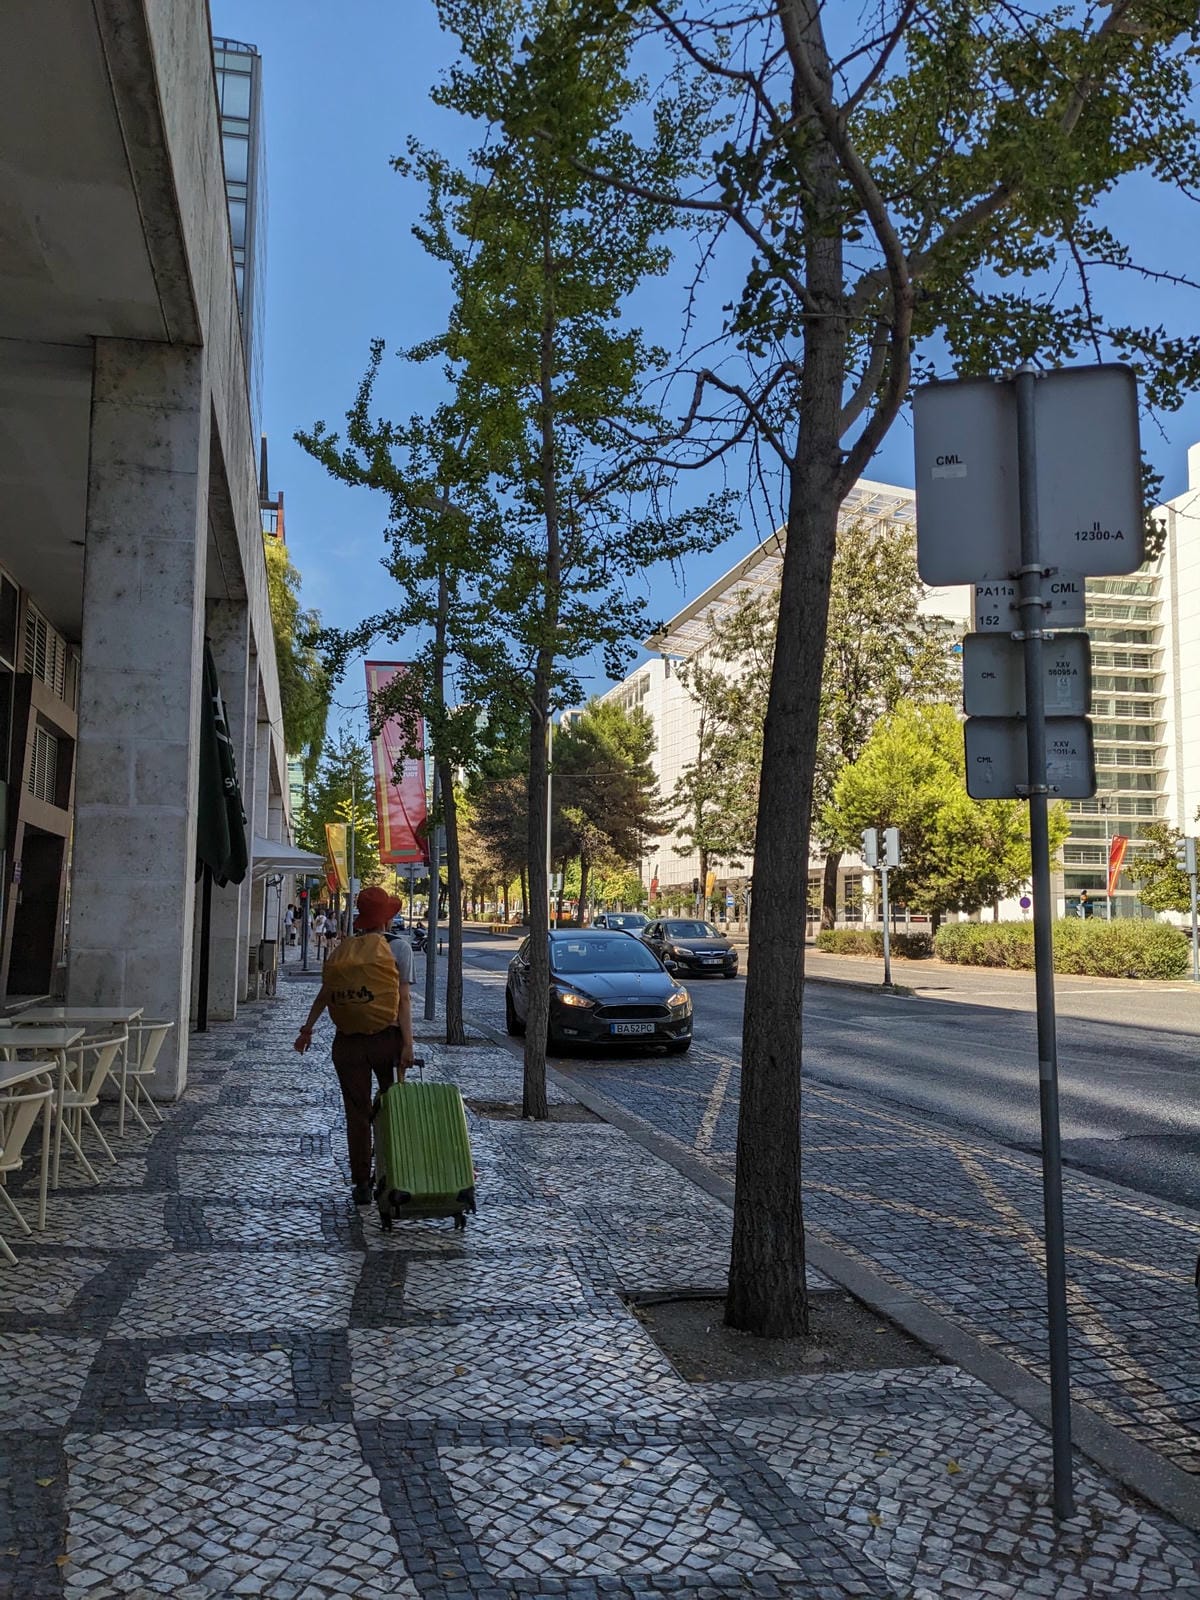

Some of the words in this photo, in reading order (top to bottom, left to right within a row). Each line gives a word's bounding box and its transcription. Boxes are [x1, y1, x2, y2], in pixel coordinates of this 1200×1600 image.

[936, 454, 963, 466] CML
[1074, 530, 1124, 541] 12300-A
[976, 586, 1015, 597] PA11a
[1051, 583, 1079, 593] CML
[980, 616, 1000, 625] 152
[616, 1024, 653, 1033] BA52PC
